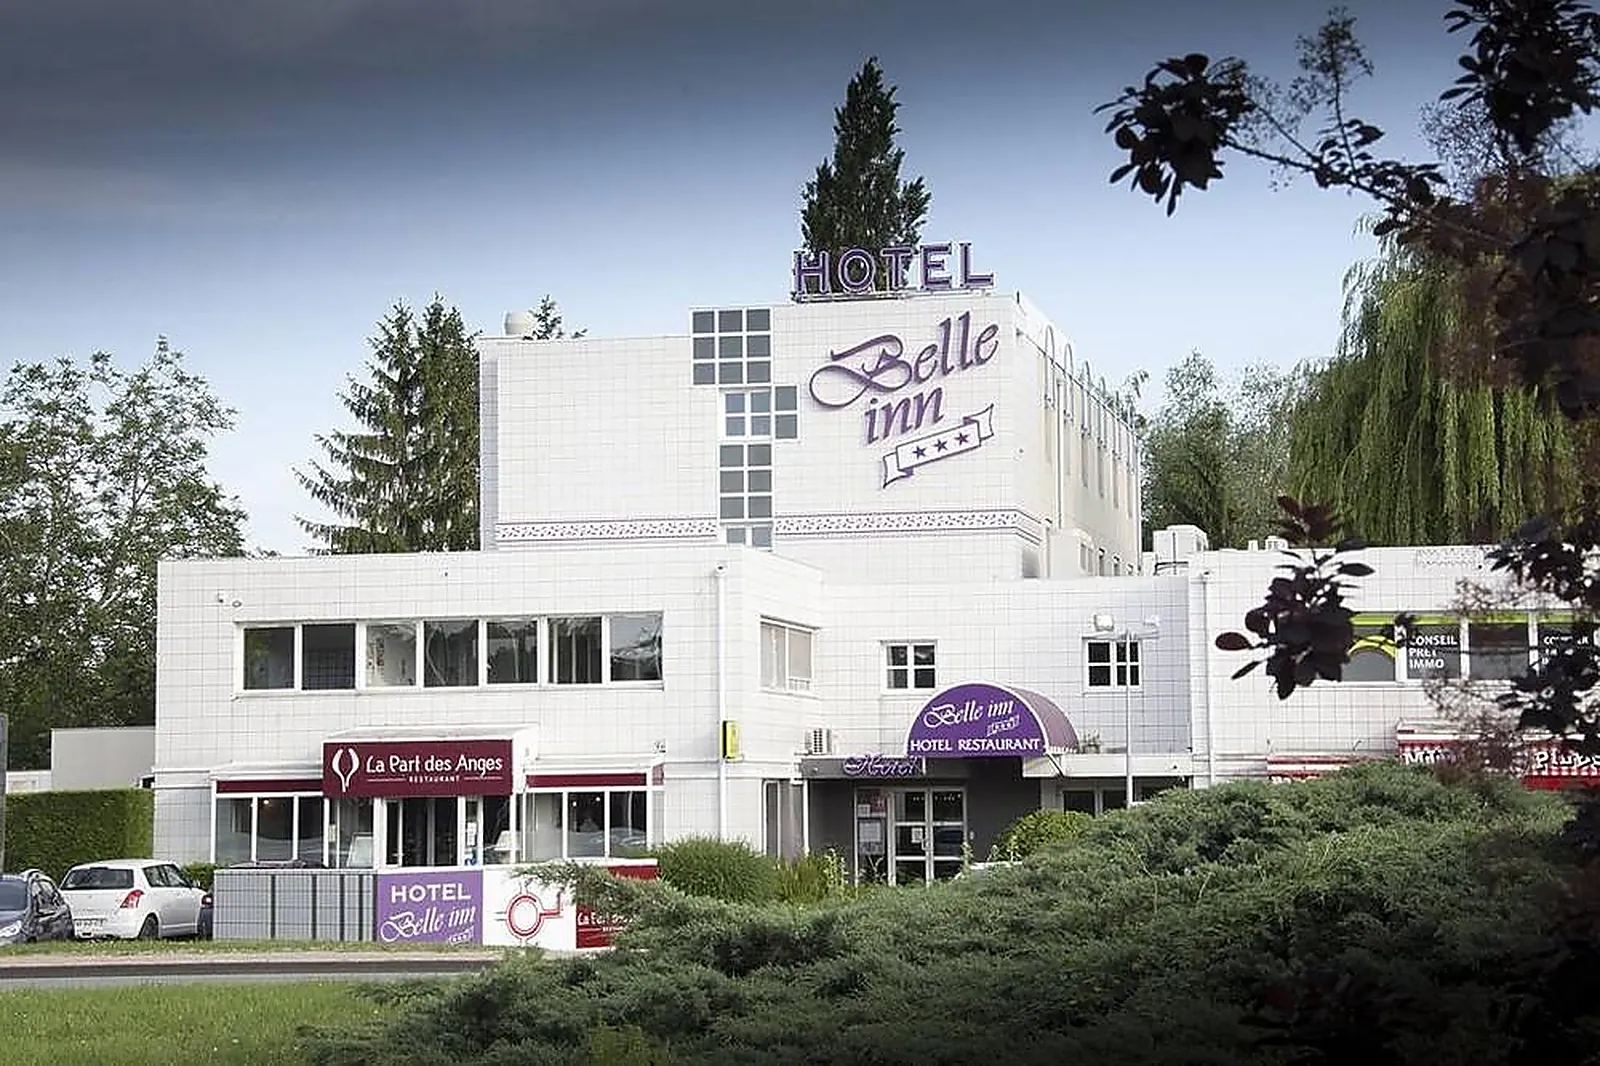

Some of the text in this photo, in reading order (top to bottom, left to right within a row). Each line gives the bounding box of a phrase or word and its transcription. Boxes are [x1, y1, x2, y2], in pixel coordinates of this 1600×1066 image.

[793, 242, 994, 294] HOTEL
[809, 311, 999, 408] Belle
[864, 387, 944, 444] inn
[1409, 658, 1445, 669] IMMO
[923, 699, 1014, 728] Belle inn
[910, 738, 1041, 751] HOTEL RESTAURANT
[366, 754, 503, 776] La Part des Anges
[408, 775, 460, 783] RESTAURANT
[391, 883, 471, 903] HOTEL
[380, 905, 477, 943] Belle inn
